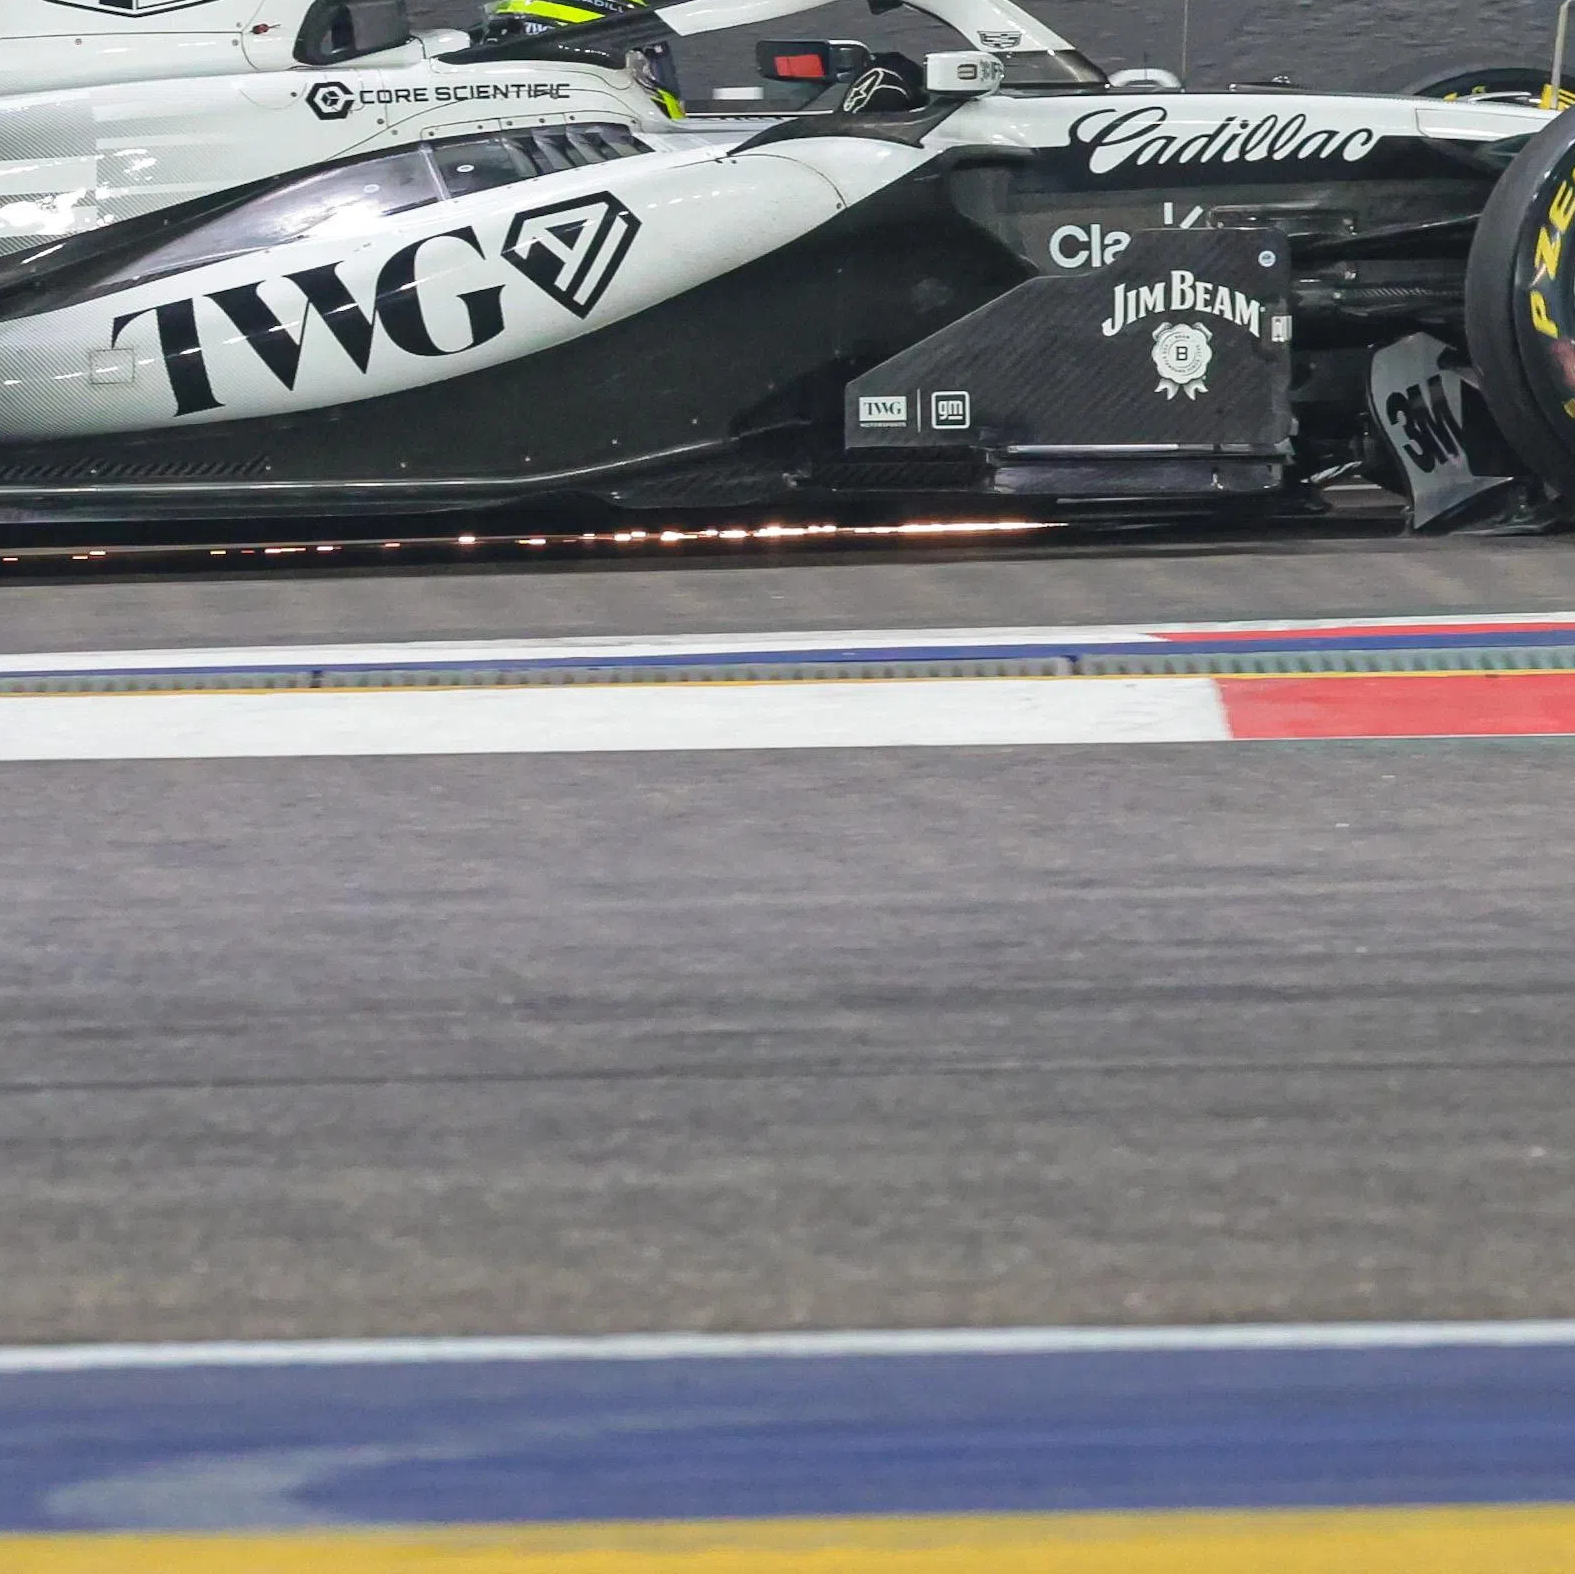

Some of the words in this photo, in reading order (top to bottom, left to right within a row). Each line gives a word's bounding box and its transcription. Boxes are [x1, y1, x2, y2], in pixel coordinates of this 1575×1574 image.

[359, 87, 429, 104] CORE
[435, 83, 570, 102] SCIENTIFIC
[1068, 106, 1374, 174] Cadillac
[1049, 224, 1131, 268] Cla
[111, 226, 506, 417] TWG
[1102, 282, 1166, 336] JIM
[1170, 270, 1260, 338] BEAM
[1530, 290, 1559, 338] P
[864, 401, 902, 416] TWG
[937, 400, 964, 420] gm
[1386, 374, 1463, 473] 3M
